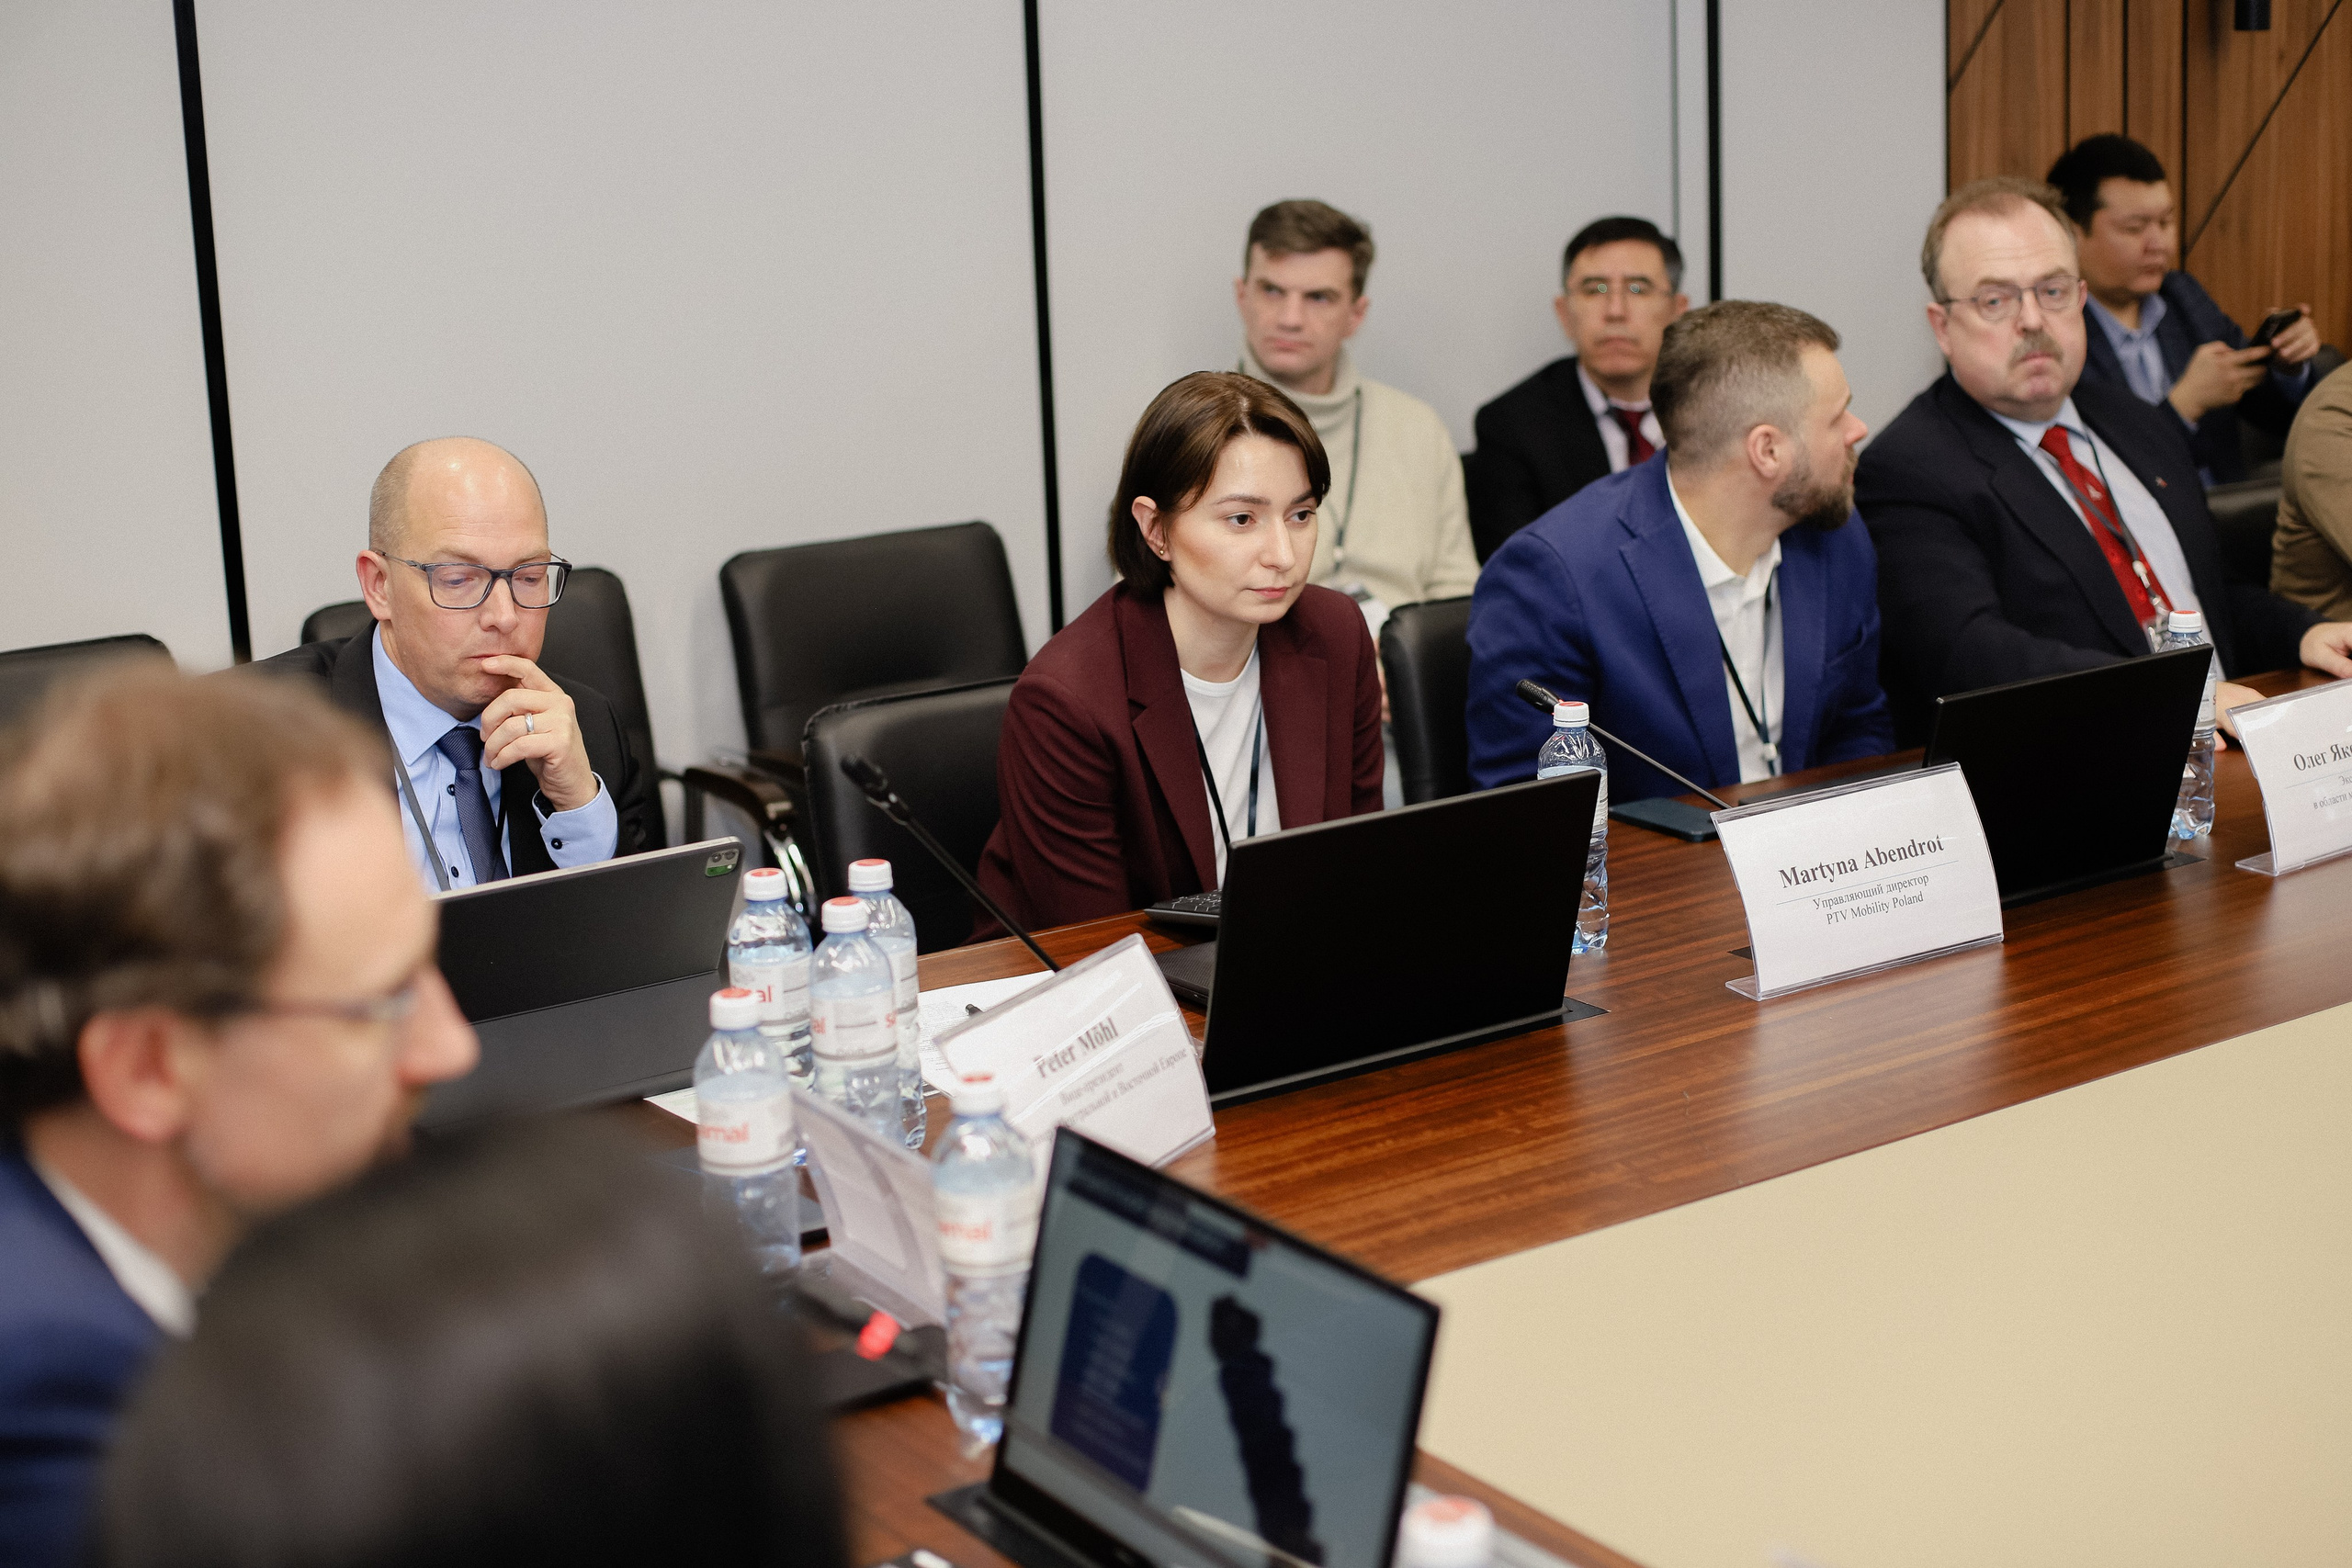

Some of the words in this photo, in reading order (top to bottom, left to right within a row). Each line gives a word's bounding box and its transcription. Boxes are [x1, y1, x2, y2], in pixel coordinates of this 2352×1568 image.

[2293, 751, 2327, 771] Олег
[2319, 794, 2347, 808] области
[1778, 857, 1859, 888] Martyna
[1813, 884, 1884, 910] Управляющий
[1886, 874, 1929, 894] директор
[1826, 908, 1848, 925] PTV
[1851, 899, 1890, 919] Mobility
[1892, 891, 1924, 908] Poland
[1078, 1015, 1118, 1055] Möhl
